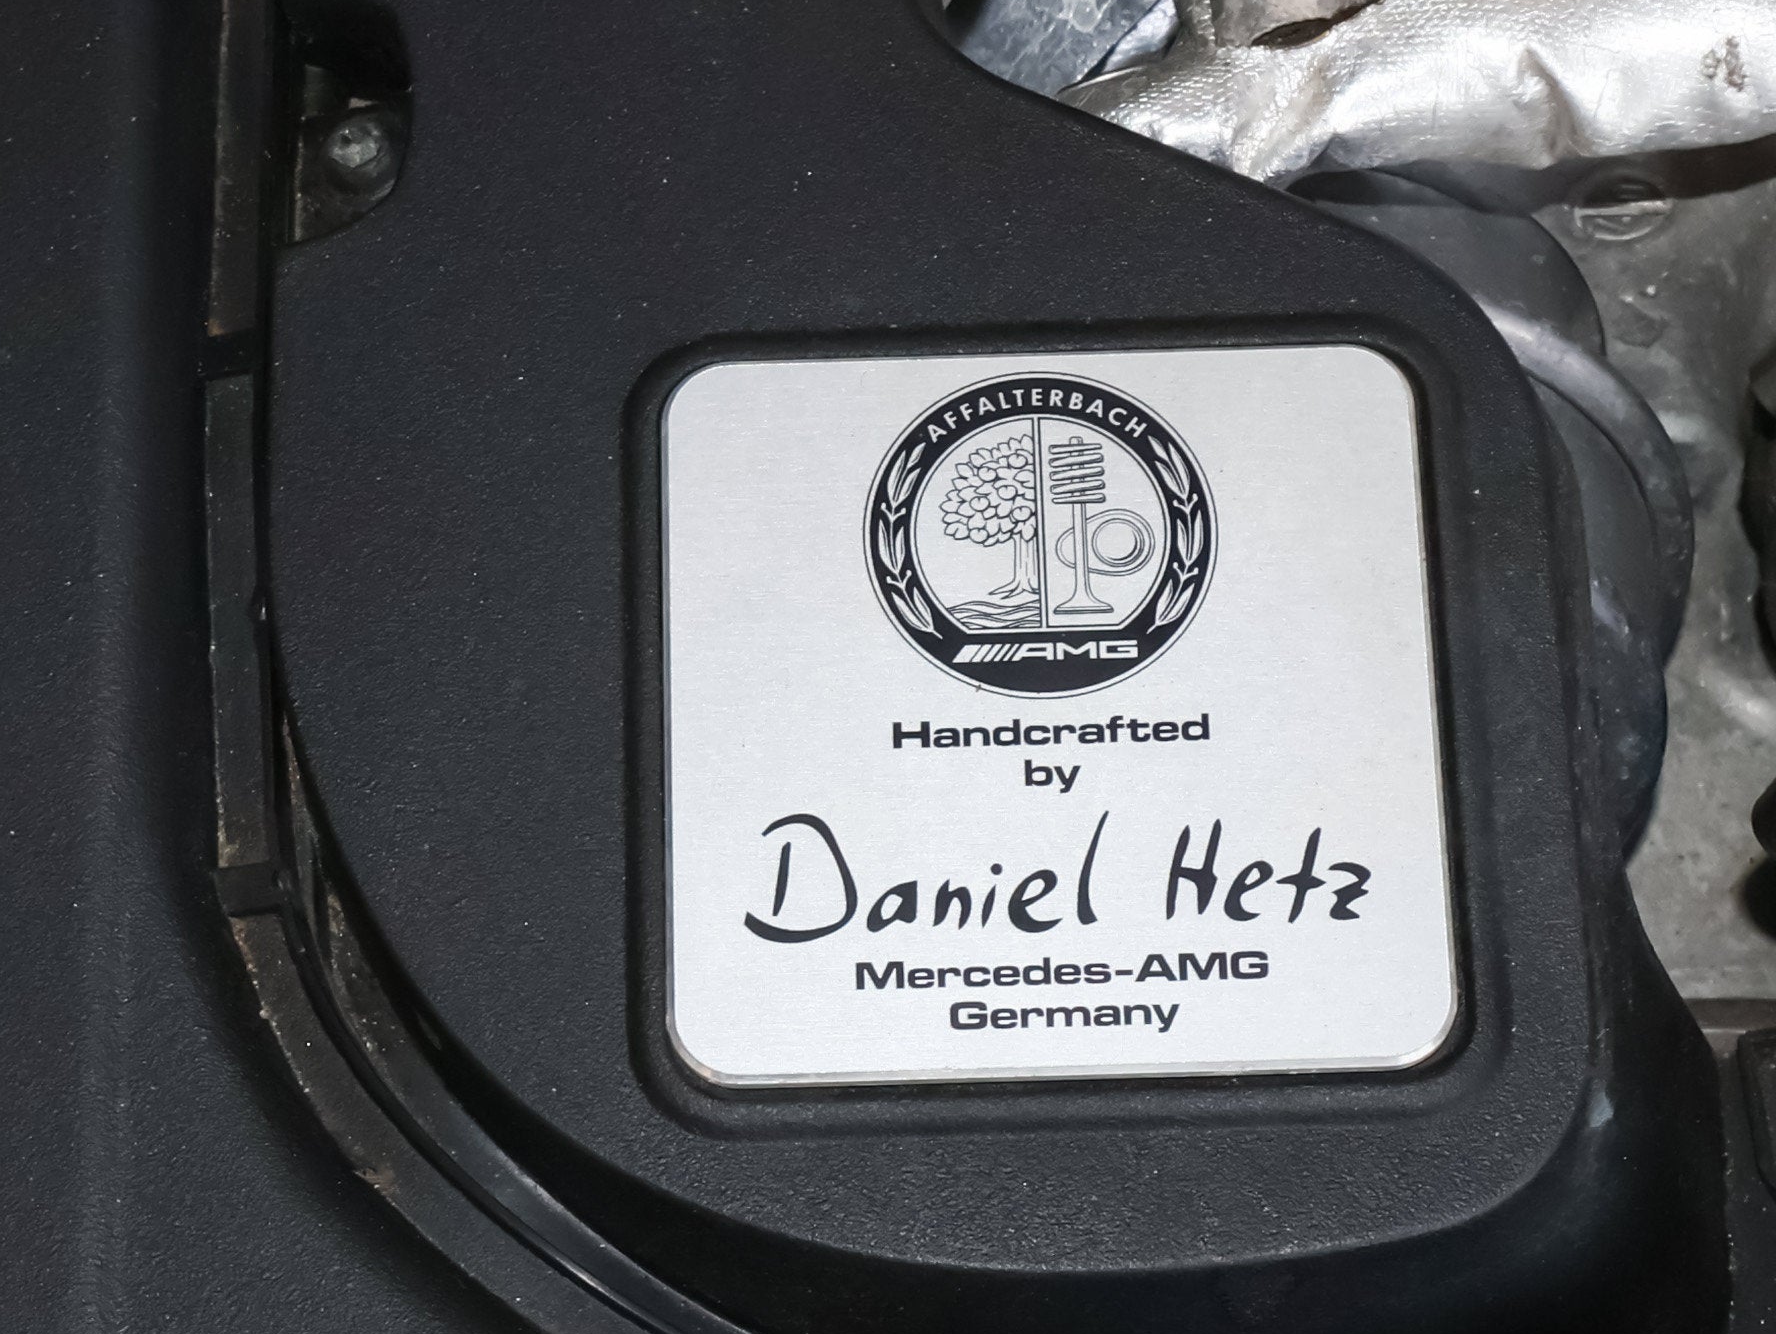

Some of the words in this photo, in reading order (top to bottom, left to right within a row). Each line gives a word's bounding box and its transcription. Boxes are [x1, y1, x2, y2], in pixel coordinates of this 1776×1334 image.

[922, 386, 1148, 444] AFFALTERBACH
[1015, 639, 1139, 662] AMG
[891, 712, 1211, 751] Handcrafted
[1023, 757, 1082, 793] by
[744, 810, 1111, 944] Daniel
[1164, 818, 1373, 924] Hetz
[854, 950, 1271, 992] Mercedes-AMG
[949, 999, 1181, 1035] Germany
